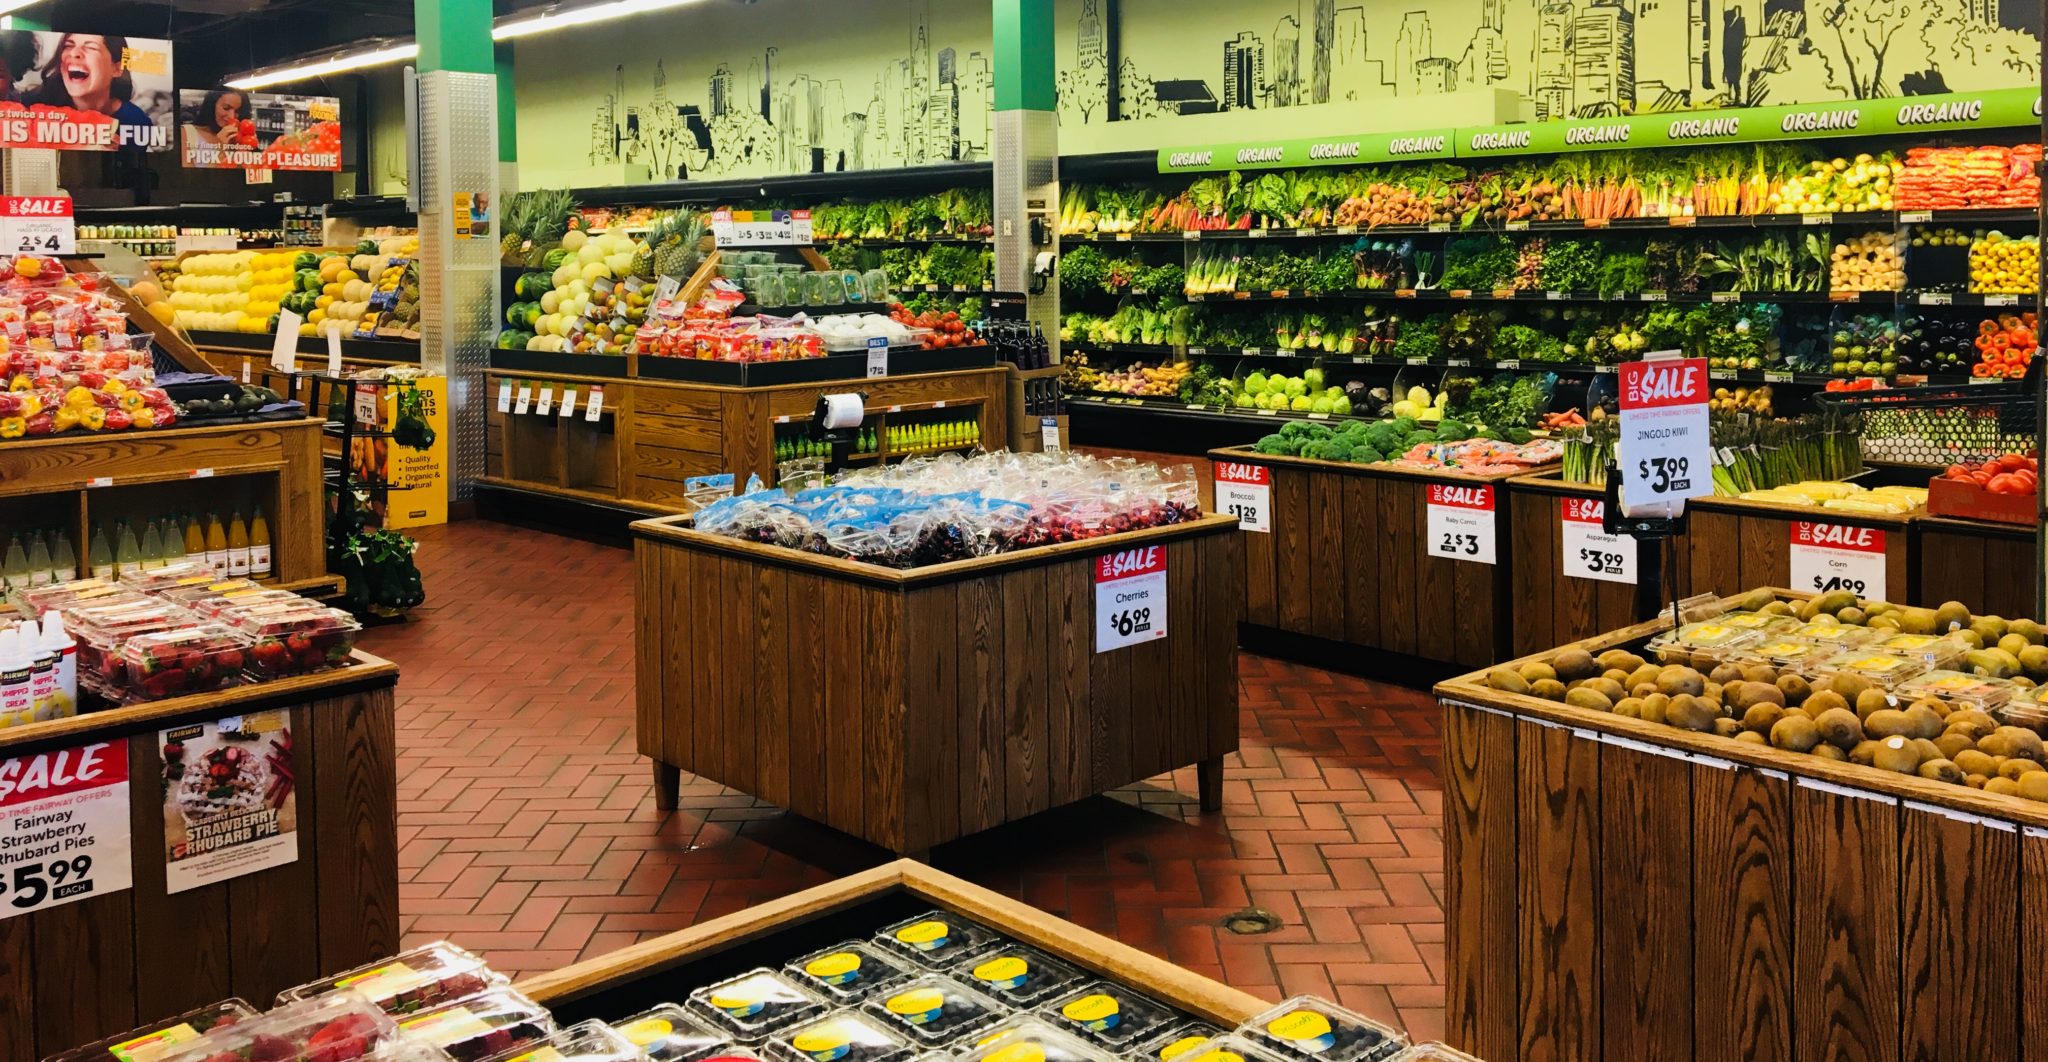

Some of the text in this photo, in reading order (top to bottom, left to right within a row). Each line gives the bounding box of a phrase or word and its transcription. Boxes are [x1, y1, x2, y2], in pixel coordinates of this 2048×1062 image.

[7, 109, 36, 118] twice
[38, 111, 45, 119] a
[48, 111, 69, 121] day.
[1781, 109, 1860, 132] ORGANIC
[1897, 100, 1983, 126] ORGANIC
[3, 120, 167, 147] IS MORE FUN
[1565, 124, 1631, 145] ORGANIC
[1668, 117, 1740, 139] ORGANIC
[200, 141, 221, 149] finest
[1389, 136, 1444, 155] ORGANIC
[1471, 130, 1531, 150] ORGANIC
[1236, 147, 1284, 164] ORGANIC
[1309, 142, 1361, 159] ORGANIC
[187, 151, 338, 167] PICK YOUR PLEASURE
[1169, 151, 1213, 167] ORGANIC
[9, 200, 18, 214] BIG
[22, 236, 30, 245] 2
[1628, 371, 1639, 401] BIG
[1637, 426, 1689, 441] JINGOLD KIWI
[405, 456, 431, 466] Quality
[405, 463, 439, 473] Imported
[405, 473, 433, 482] Organic
[1673, 480, 1688, 489] EACH
[1230, 491, 1256, 501] Broccoli
[1433, 484, 1442, 501] BIG
[1569, 499, 1579, 517] BIG
[1446, 516, 1459, 524] Baby
[1443, 533, 1452, 545] 2
[1586, 533, 1618, 543] Asparagus
[1800, 521, 1810, 541] BIG
[1103, 554, 1112, 577] BIG
[1829, 559, 1848, 568] Corn
[1116, 589, 1149, 603] Cherries
[169, 727, 201, 739] FAIRWAY
[9, 806, 31, 818] TIME
[33, 798, 73, 812] FAIRWAY
[76, 789, 113, 803] OFFERS
[15, 810, 73, 831] Fairway
[186, 808, 277, 841] STRAWBERRY
[2, 822, 87, 849] Strawberry
[64, 836, 95, 851] Pies
[186, 821, 279, 855] RHUBARB PIE
[60, 884, 86, 897] EACH
